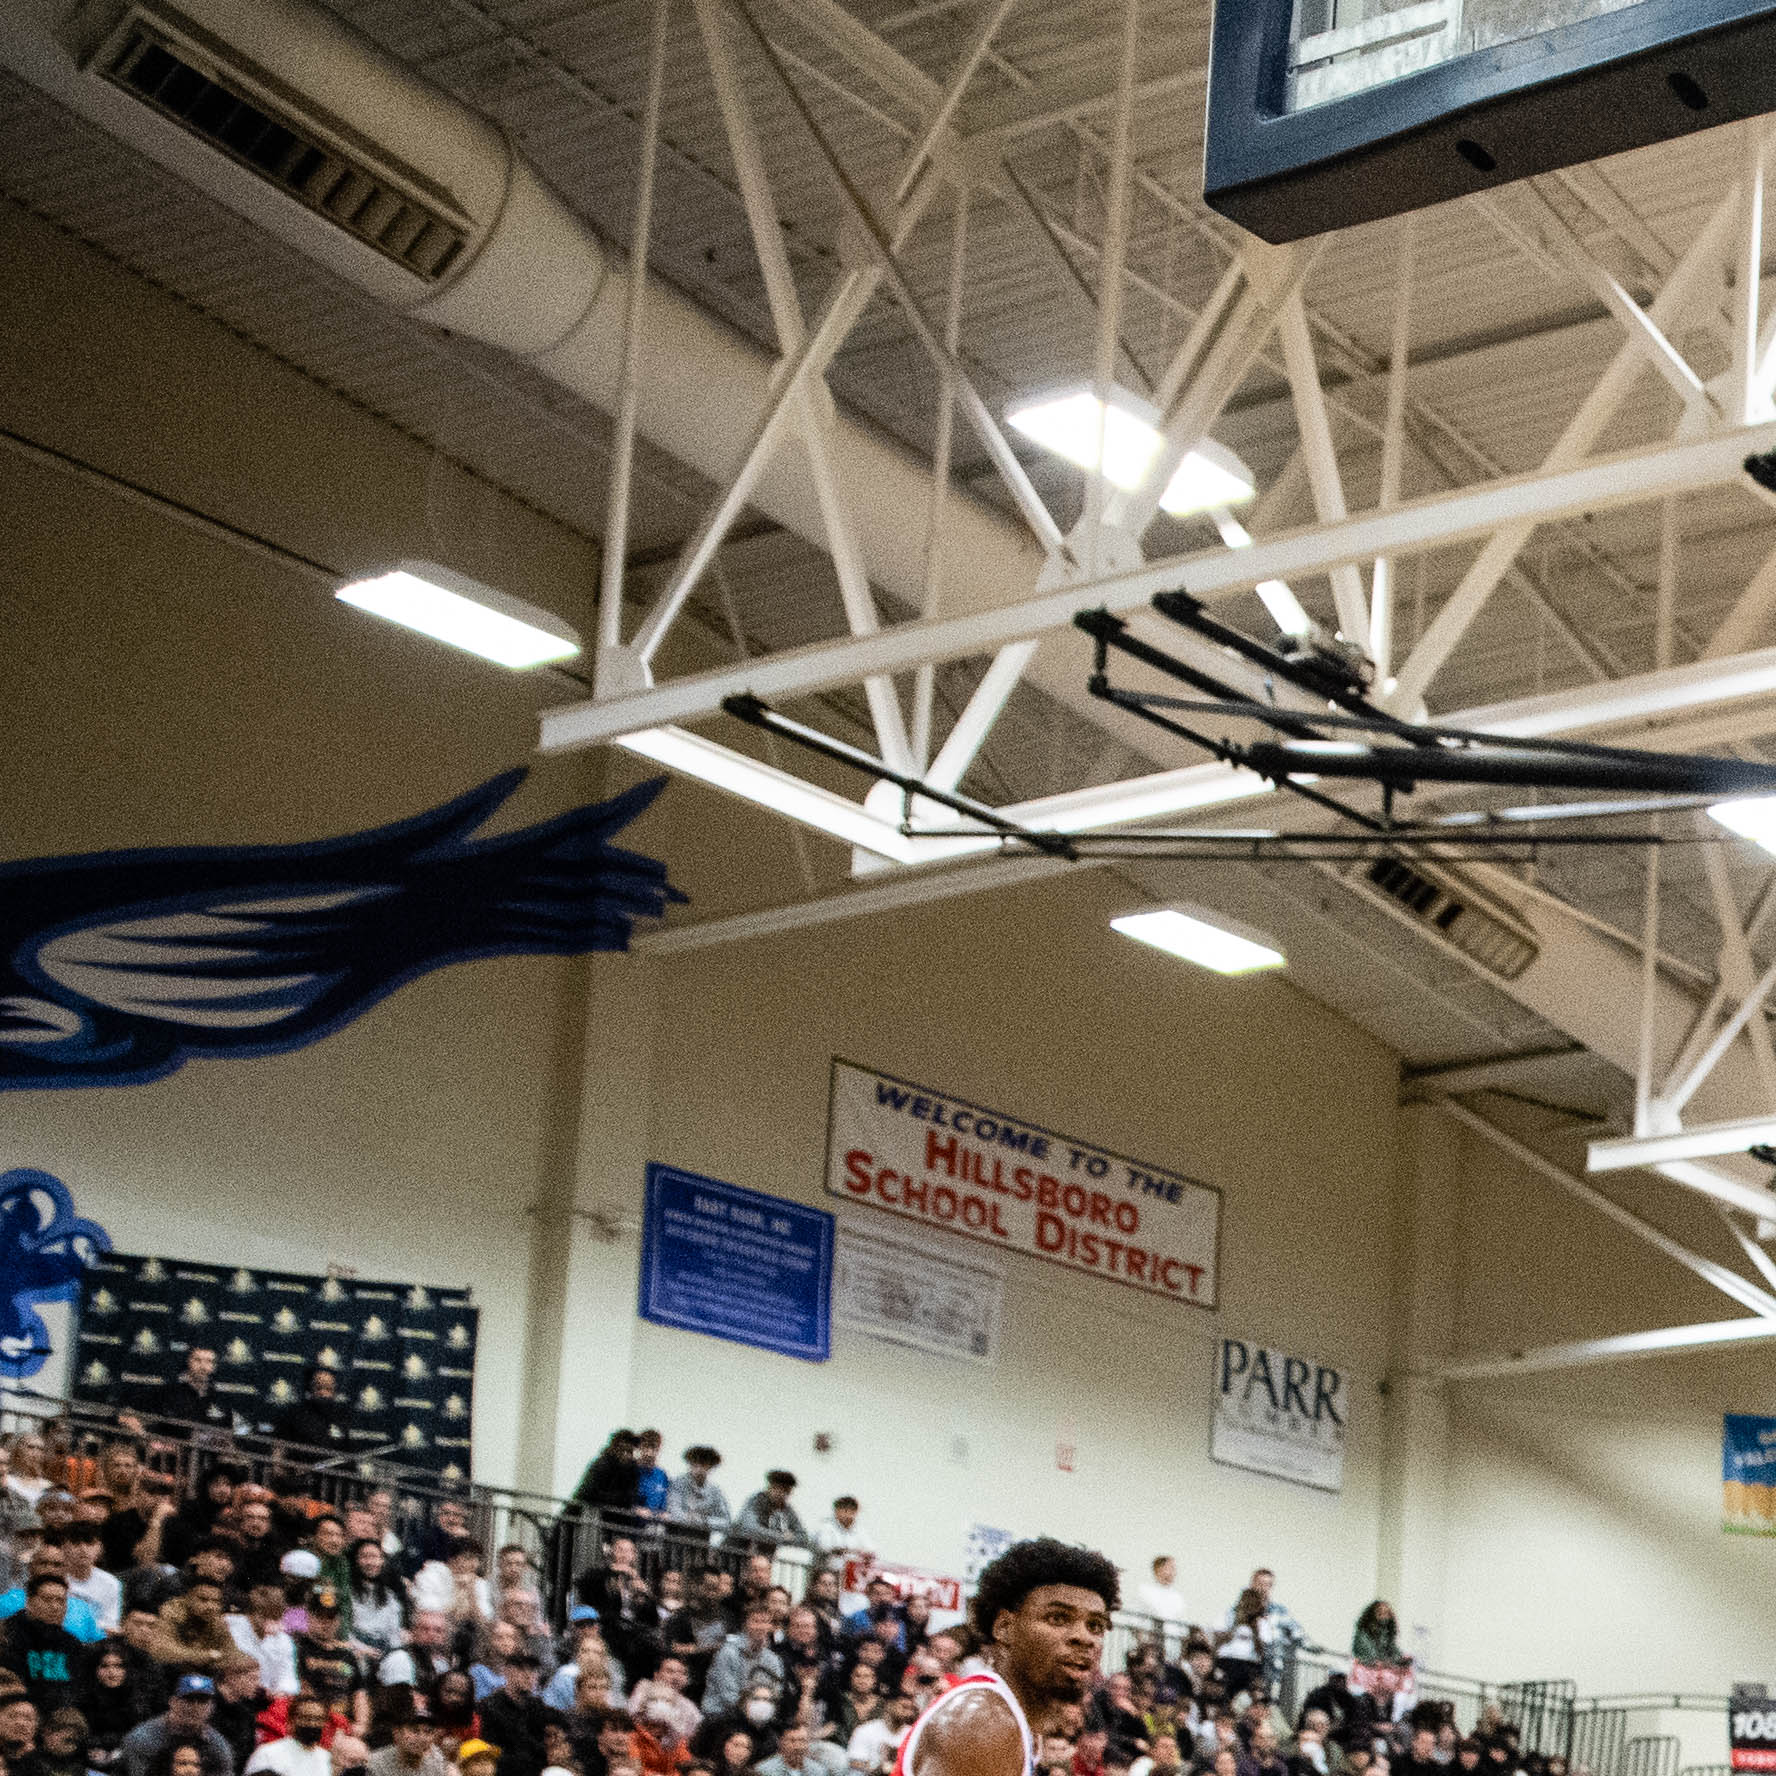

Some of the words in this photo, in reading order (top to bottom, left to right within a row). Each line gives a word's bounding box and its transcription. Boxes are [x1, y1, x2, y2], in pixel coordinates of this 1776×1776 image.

[874, 1082, 1050, 1160] WELCOME
[1068, 1148, 1110, 1180] TO
[1127, 1165, 1185, 1204] THE
[1221, 1338, 1345, 1427] PARR
